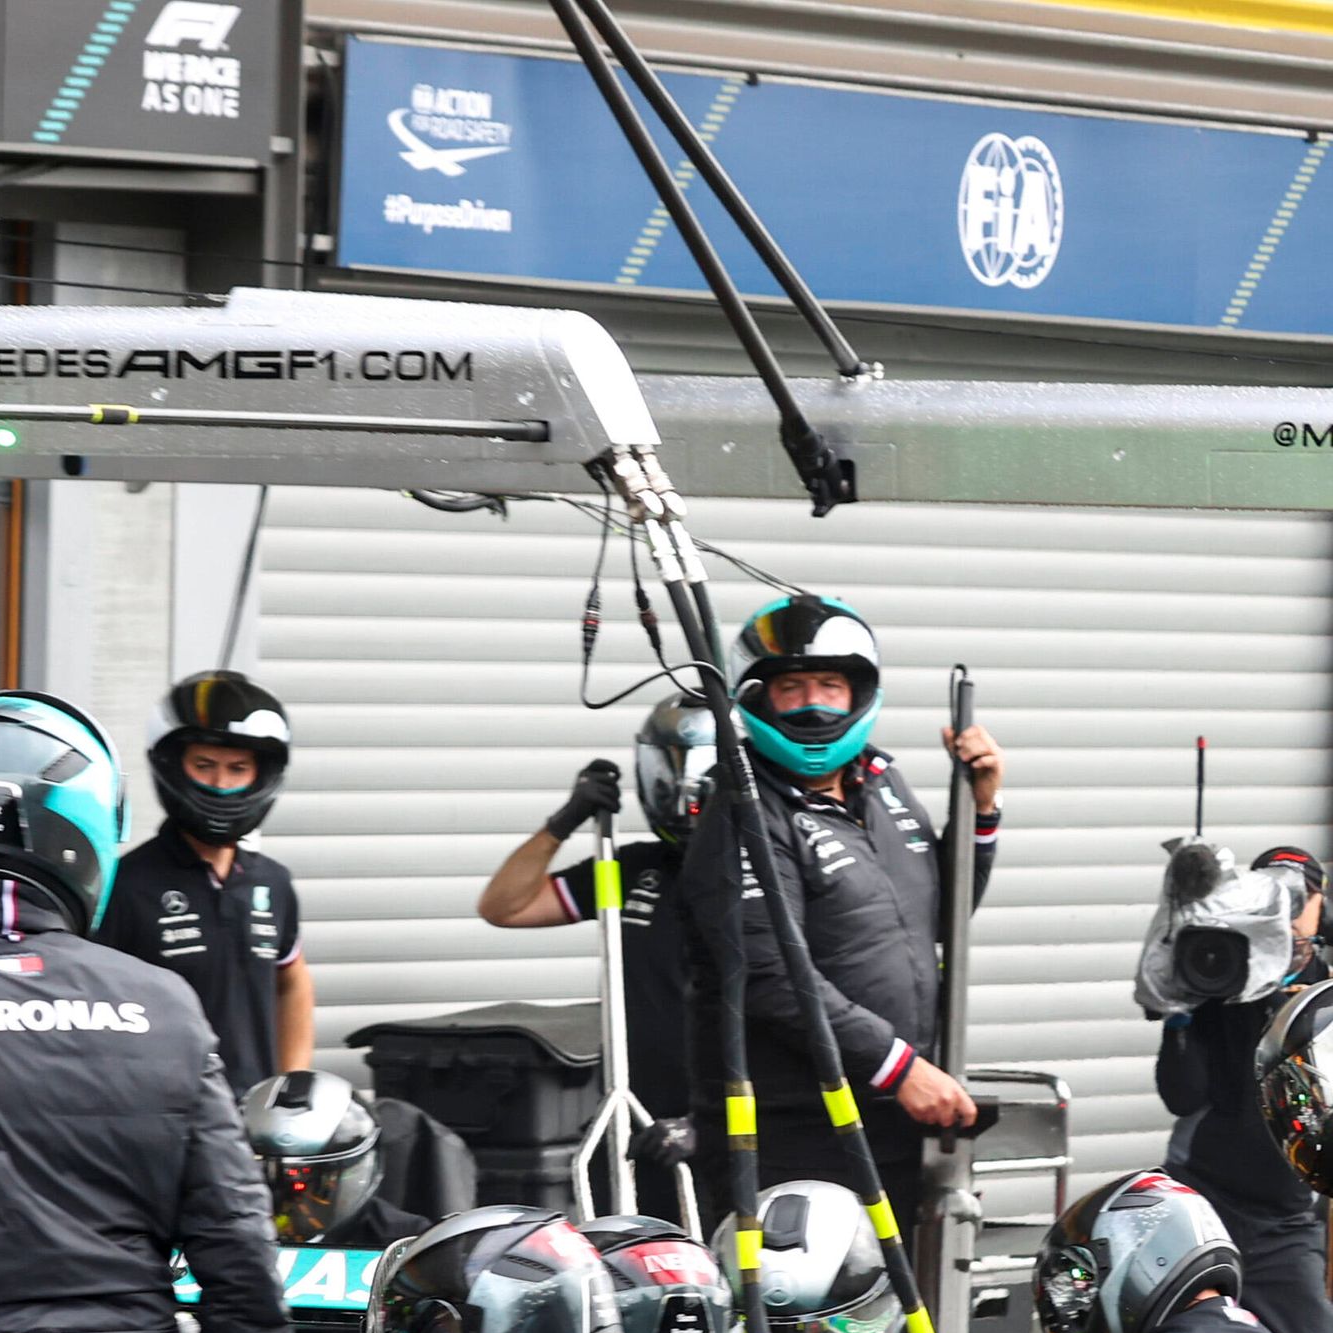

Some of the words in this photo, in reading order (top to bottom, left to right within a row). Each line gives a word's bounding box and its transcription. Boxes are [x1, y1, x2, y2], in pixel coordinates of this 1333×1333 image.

[143, 50, 183, 82] WE
[183, 54, 241, 88] RACE
[141, 81, 181, 113] AS
[183, 84, 240, 119] ONE
[435, 87, 492, 120] ACTION
